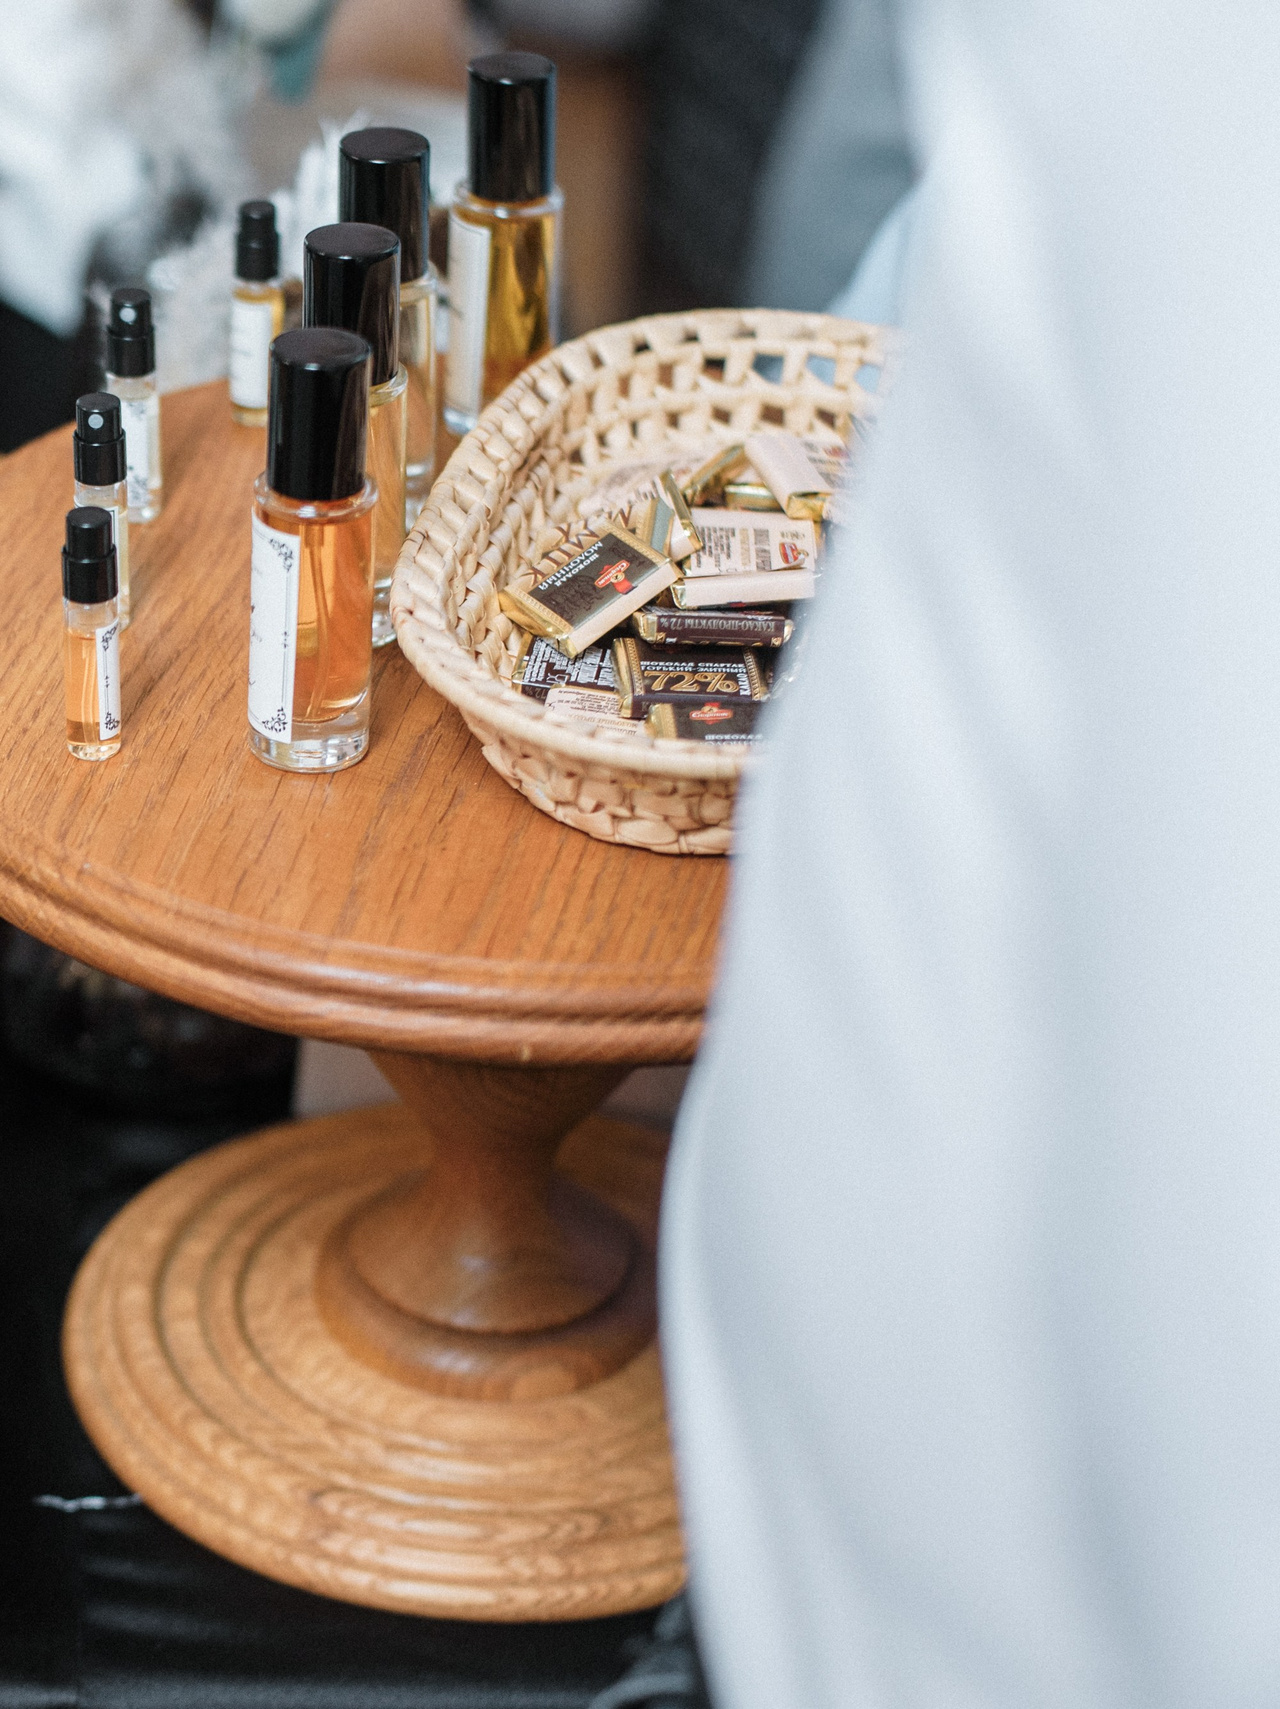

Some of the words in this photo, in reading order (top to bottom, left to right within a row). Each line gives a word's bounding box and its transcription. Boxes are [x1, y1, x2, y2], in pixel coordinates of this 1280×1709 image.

[521, 528, 600, 587] MILK
[538, 541, 603, 590] МОЛОЧНЫЙ
[554, 553, 599, 587] ШОКОЛАД
[597, 562, 627, 585] Спартак
[670, 617, 682, 631] 72
[684, 618, 775, 632] КАКАО-ПРОДУКТЫ
[644, 670, 740, 693] 72%
[737, 673, 752, 696] КАКАО
